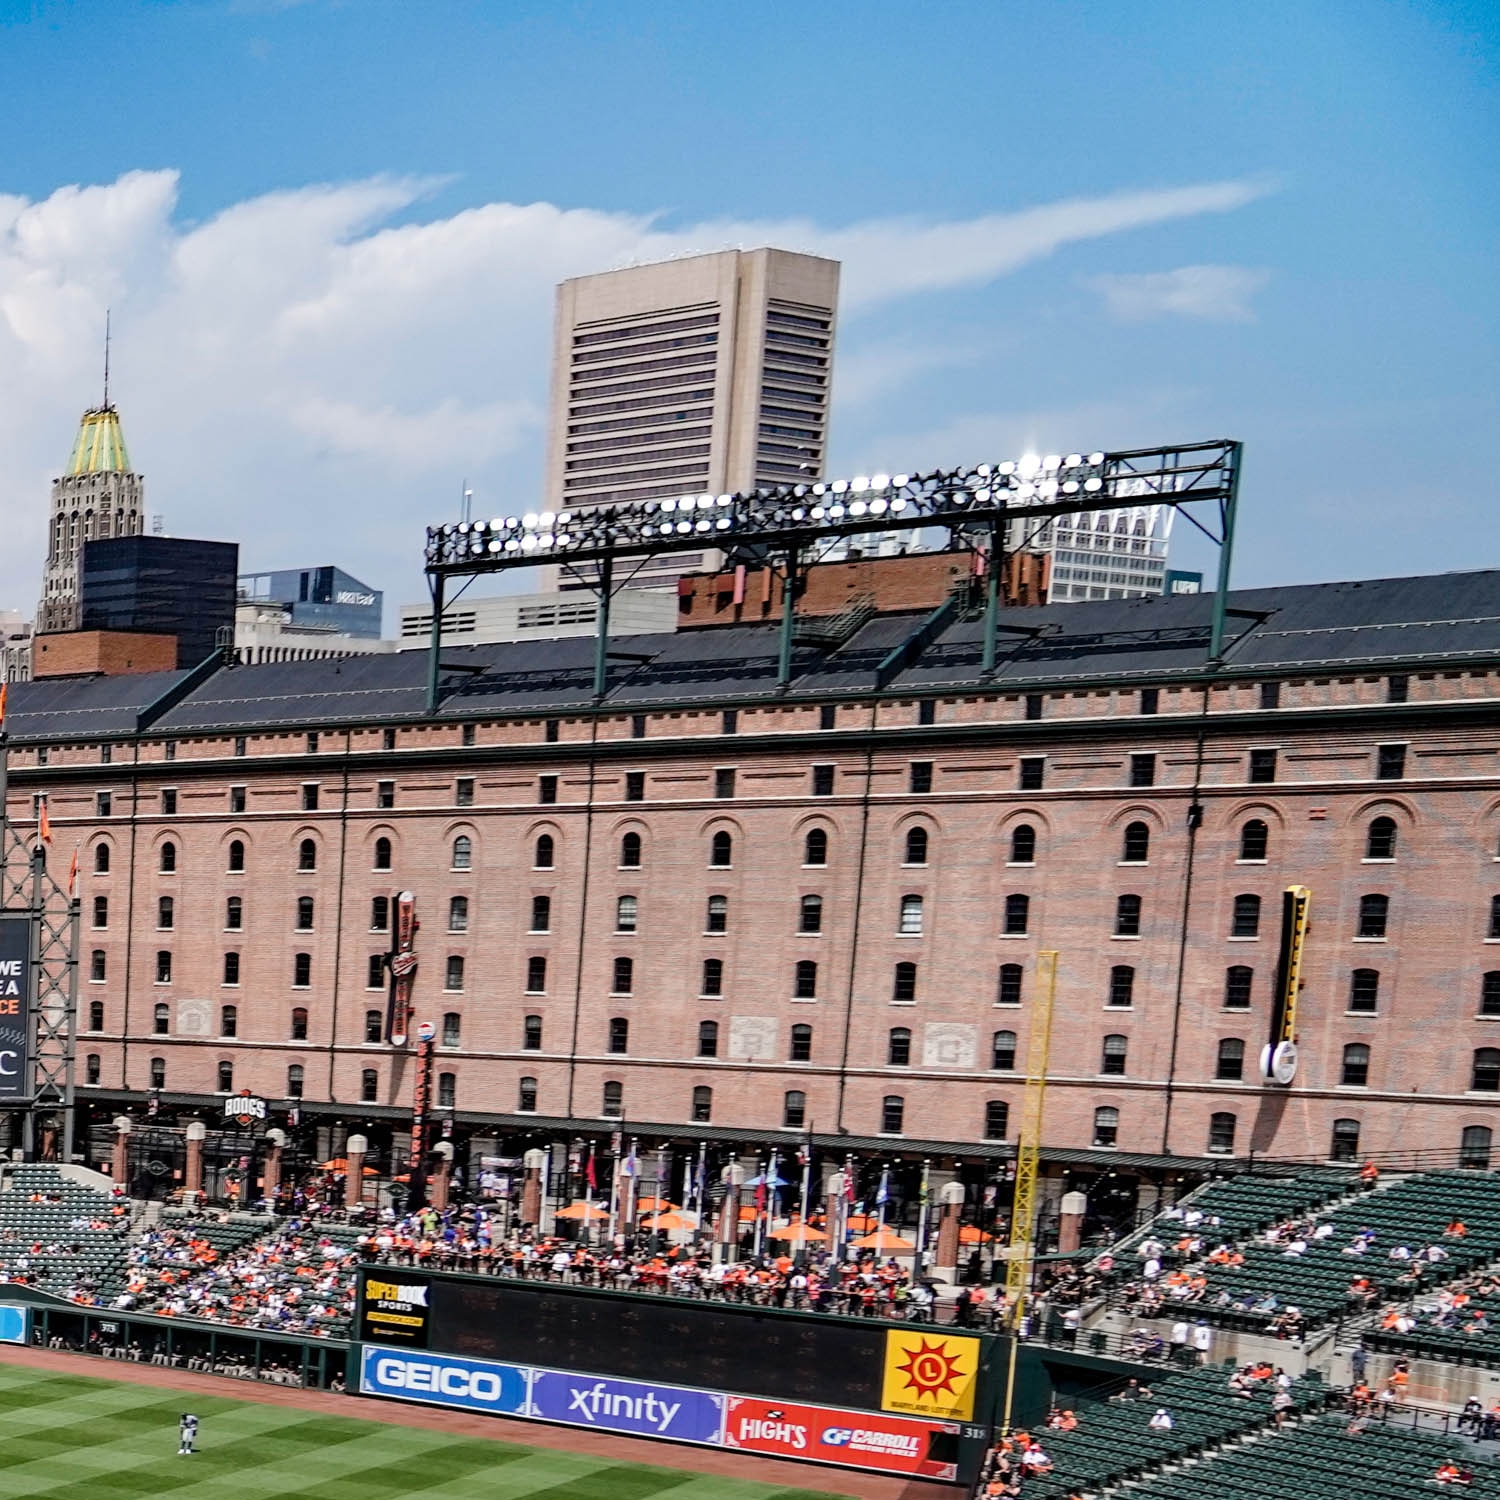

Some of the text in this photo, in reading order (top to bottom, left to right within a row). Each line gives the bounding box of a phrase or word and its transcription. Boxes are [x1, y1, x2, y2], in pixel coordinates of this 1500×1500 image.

[5, 980, 19, 995] A
[377, 1300, 413, 1311] SPORTS
[376, 1358, 502, 1401] GEICO
[568, 1382, 681, 1432] xfinity
[740, 1417, 807, 1449] HIGH'S
[851, 1429, 921, 1450] CARROLL
